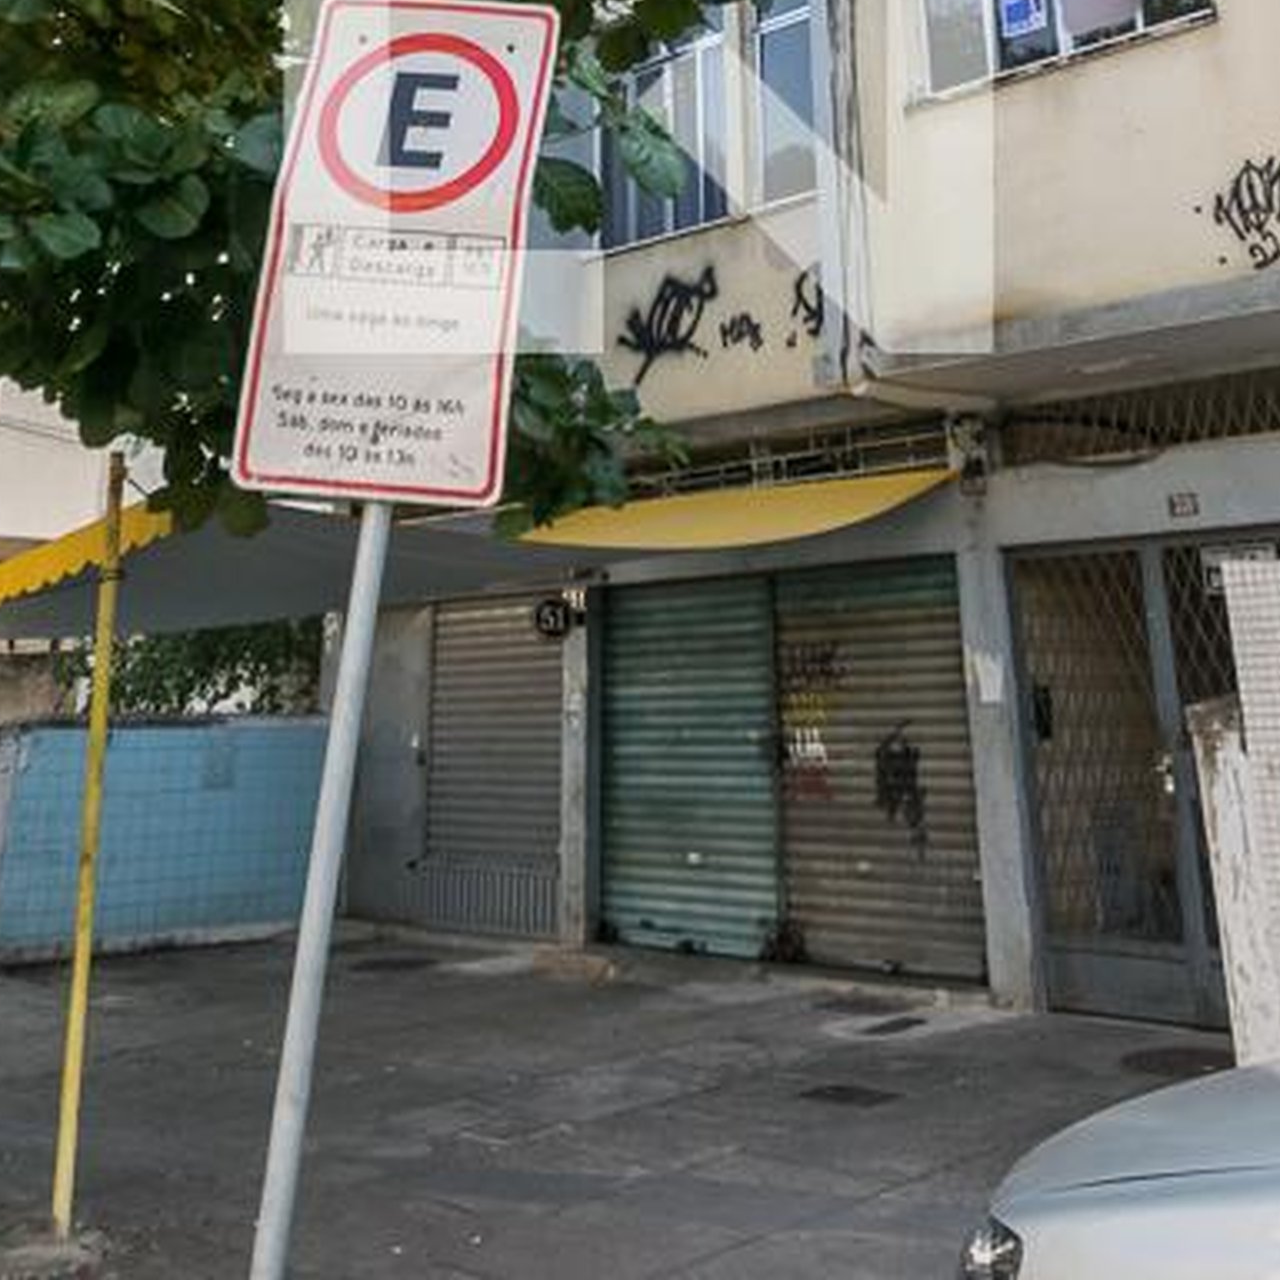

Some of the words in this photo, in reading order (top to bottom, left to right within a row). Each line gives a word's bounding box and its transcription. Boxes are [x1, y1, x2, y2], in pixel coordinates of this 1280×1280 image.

[376, 71, 461, 171] E
[271, 382, 304, 406] Seg
[320, 389, 349, 406] sex
[352, 391, 382, 409] das
[388, 393, 409, 412] 10
[302, 441, 333, 460] das
